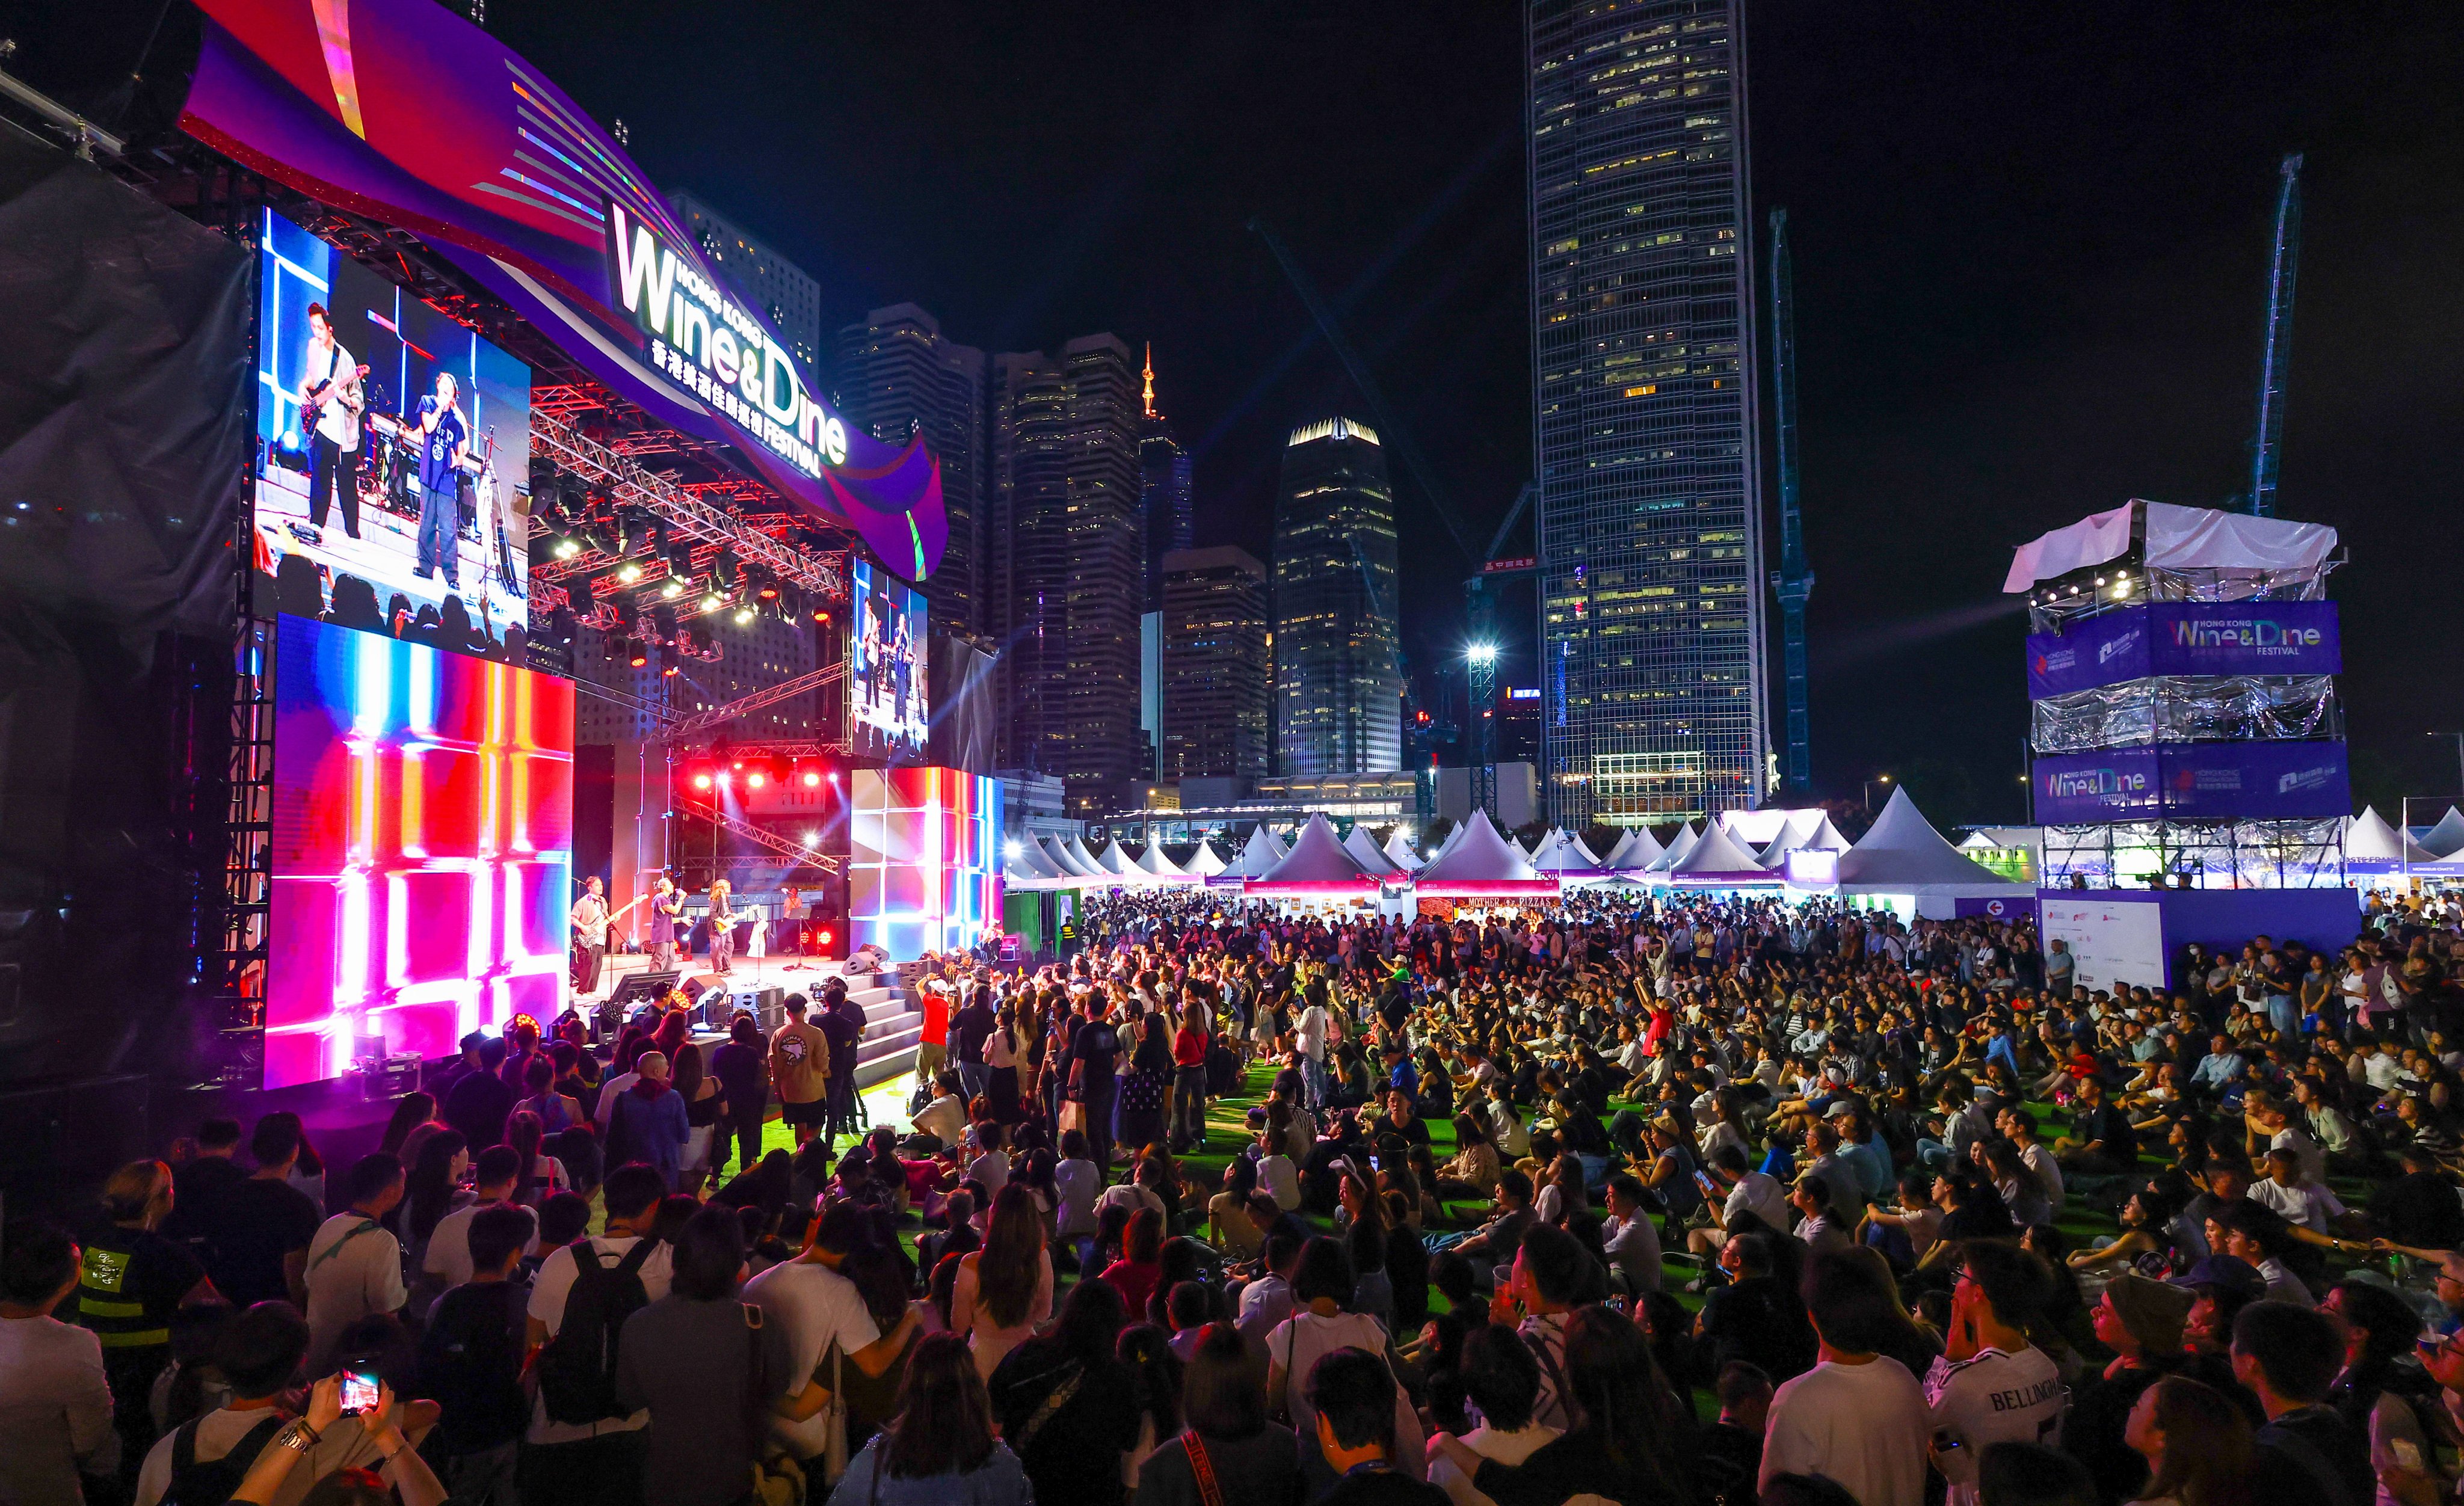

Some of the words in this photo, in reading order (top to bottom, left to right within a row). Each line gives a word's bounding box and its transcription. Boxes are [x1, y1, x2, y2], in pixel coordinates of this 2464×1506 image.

[676, 259, 721, 314] HONG
[723, 299, 763, 349] KONG
[763, 415, 822, 479] FESTIVAL
[2256, 647, 2300, 656] FESTIVAL
[2099, 792, 2131, 803] FESTIVAL
[1468, 897, 1500, 907] MOTHER
[1519, 897, 1551, 907] PIZZAS
